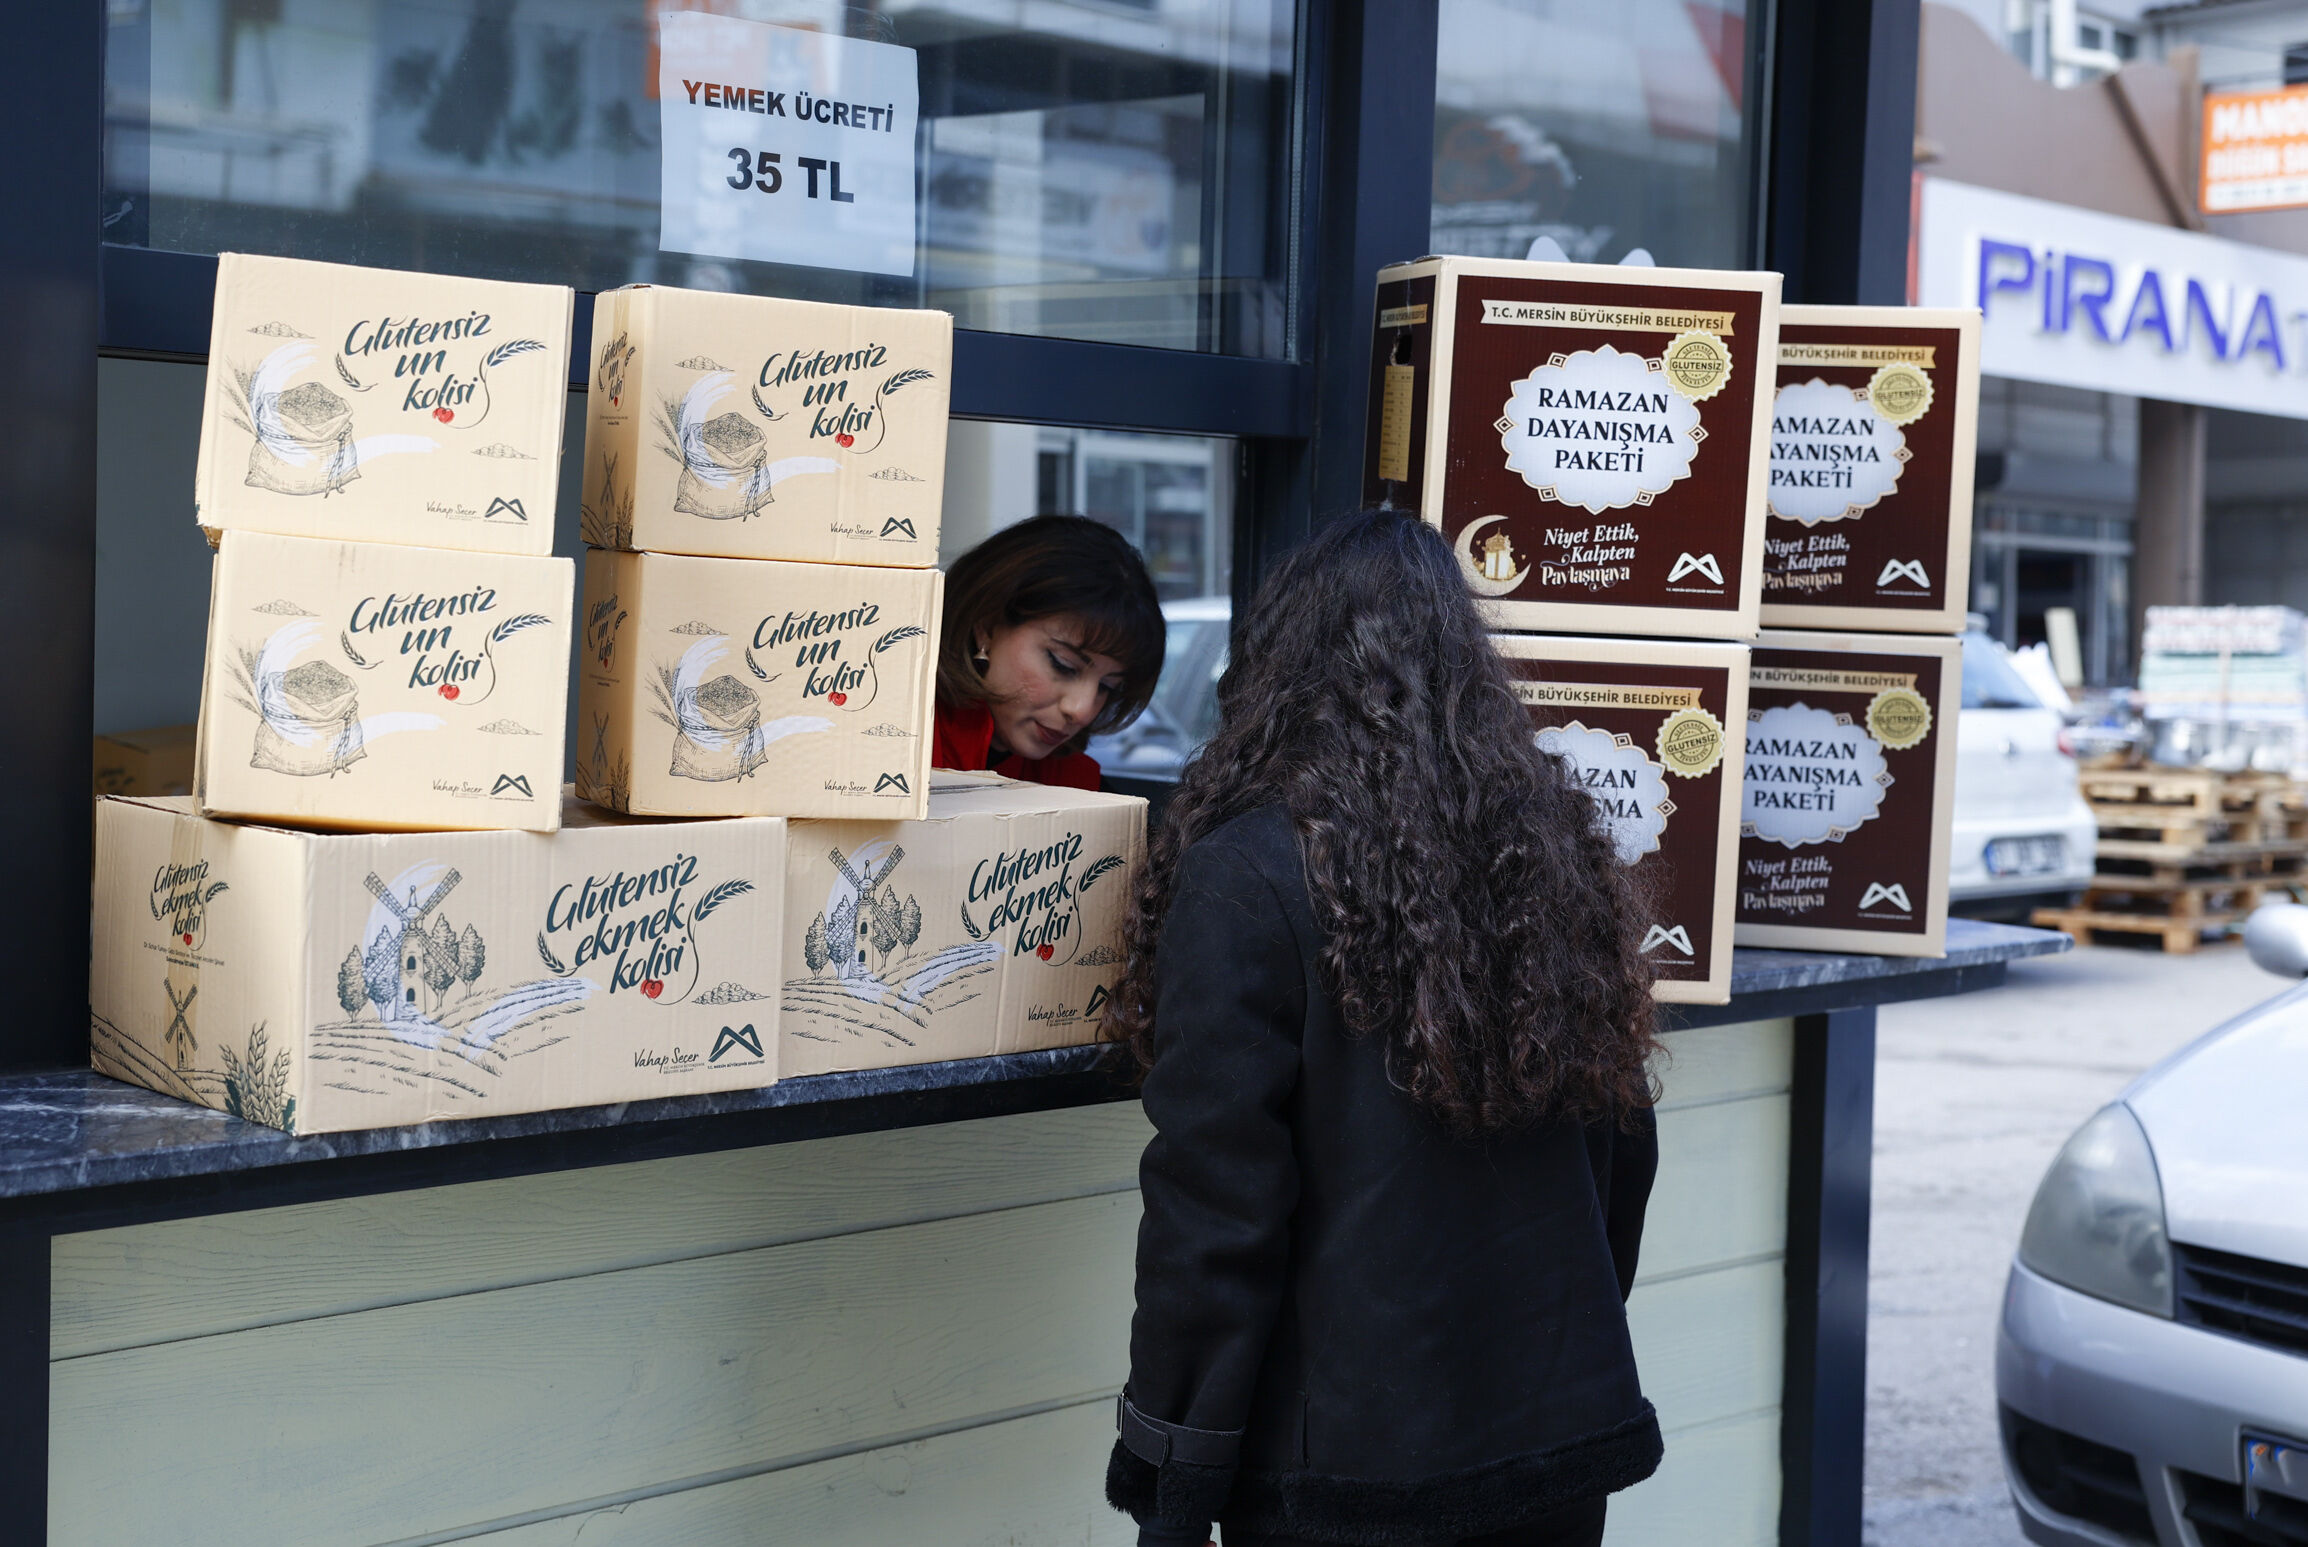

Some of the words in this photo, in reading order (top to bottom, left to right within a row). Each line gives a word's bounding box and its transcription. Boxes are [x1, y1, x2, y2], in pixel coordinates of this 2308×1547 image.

[682, 79, 786, 118] YEMEK
[795, 91, 894, 133] ÜCRETİ
[726, 147, 782, 194] 35
[798, 156, 854, 203] TL
[1491, 307, 1513, 319] T.C.
[1516, 306, 1566, 321] MERSİN
[1570, 308, 1652, 327] BÜYÜKŞEHİR
[1655, 313, 1725, 330] BELEDİYESİ
[394, 350, 447, 378] un
[1672, 361, 1722, 371] GLUTENSİZ
[1782, 347, 1857, 359] BÜYÜKŞEHİR
[1862, 348, 1926, 362] BELEDİYESİ
[402, 374, 479, 412] kolisi
[802, 380, 848, 407] un
[1538, 387, 1669, 414] RAMAZAN
[809, 402, 876, 439] kolisi
[1527, 417, 1674, 450] DAYANIŞMA
[1772, 417, 1875, 436] AMAZAN
[1554, 448, 1644, 473] PAKETİ
[1769, 443, 1881, 469] YANIŞMA
[1771, 466, 1853, 488] PAKETİ
[426, 500, 453, 518] Vahap
[830, 522, 853, 538] Vahap
[1544, 528, 1589, 549] Niyet
[1593, 522, 1640, 543] Ettik,
[1570, 545, 1636, 566] Kalpten
[1764, 537, 1804, 558] Niyet
[1807, 533, 1850, 552] Ettik,
[1787, 554, 1847, 573] Kalpten
[400, 625, 452, 655] un
[795, 639, 841, 668] un
[408, 650, 484, 689] kolisi
[802, 661, 868, 698] kolisi
[1765, 671, 1841, 685] BÜYÜKŞEHİR
[1844, 674, 1908, 688] BELEDİYESİ
[1538, 687, 1619, 704] BÜYÜKŞEHİR
[1623, 692, 1691, 706] BELEDİYESİ
[1667, 733, 1716, 753] GLUTENSİZ
[433, 779, 459, 796] Vahap
[824, 779, 847, 796] Vahap
[1744, 765, 1863, 792] AYANIŞMA
[1753, 789, 1835, 812] PAKETİ
[1746, 859, 1786, 878] Niyet
[1790, 855, 1833, 874] Ettik,
[988, 862, 1072, 933] ekmek
[1769, 875, 1830, 894] Kalpten
[162, 879, 203, 917] ekmek
[172, 908, 202, 937] kolisi
[574, 887, 685, 967] ekmek
[1014, 905, 1074, 957] kolisi
[609, 936, 687, 994] kolisi
[1028, 1003, 1055, 1027] Vahap
[634, 1048, 669, 1074] Vahap
